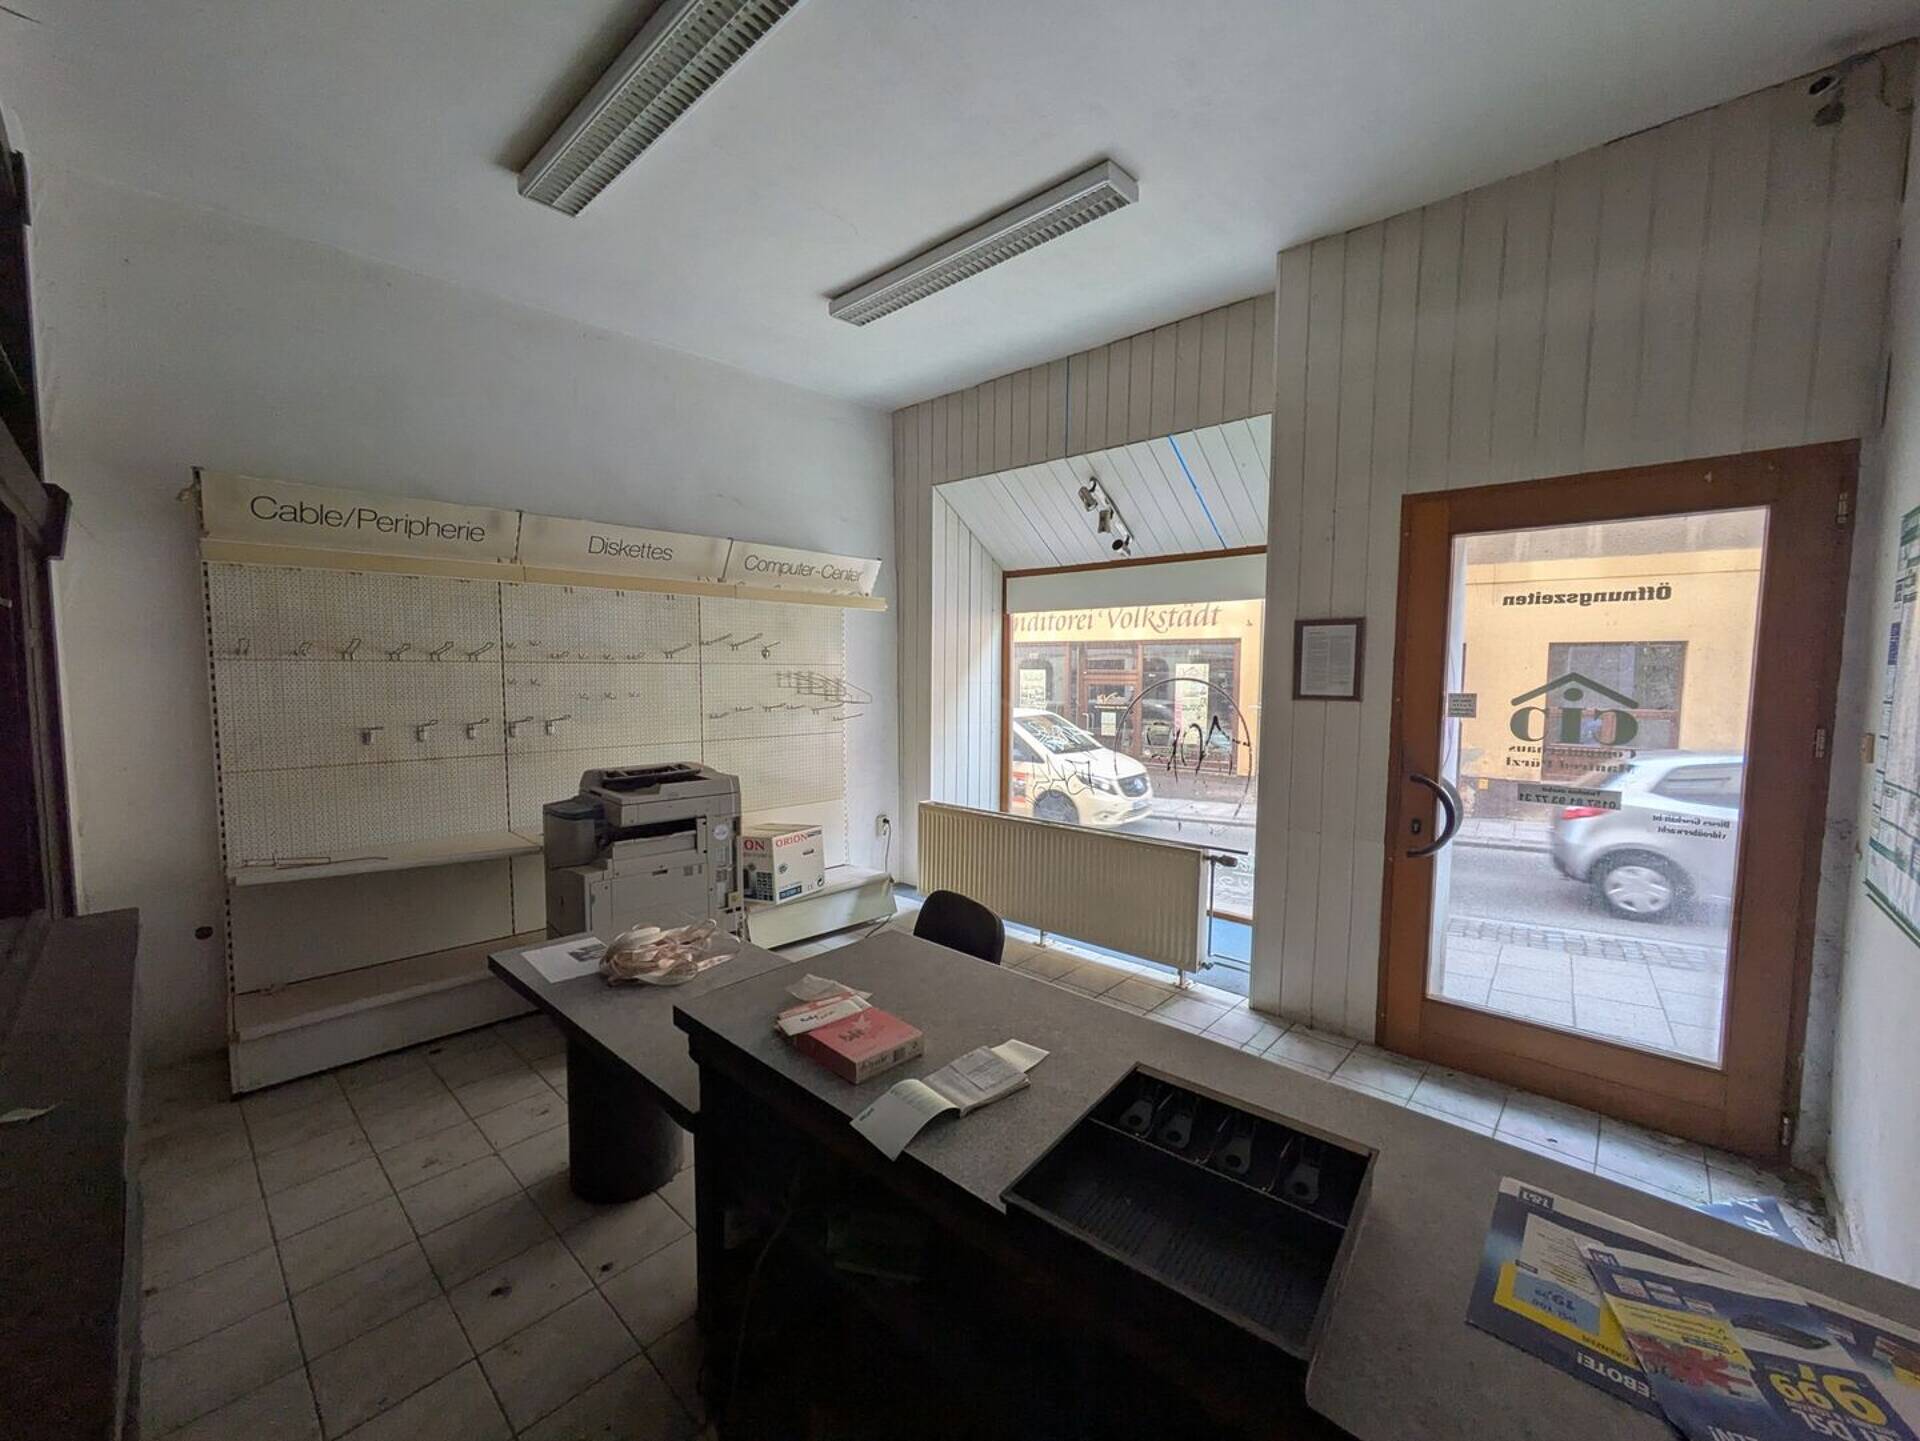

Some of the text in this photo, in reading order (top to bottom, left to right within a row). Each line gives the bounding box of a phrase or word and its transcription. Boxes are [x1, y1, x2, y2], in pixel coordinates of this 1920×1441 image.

[249, 494, 487, 544] Cable/Peripherie
[587, 535, 674, 562] Diskettes
[743, 554, 865, 583] Computer-Center
[1107, 604, 1224, 634] Volkstädt
[775, 833, 808, 848] ORION
